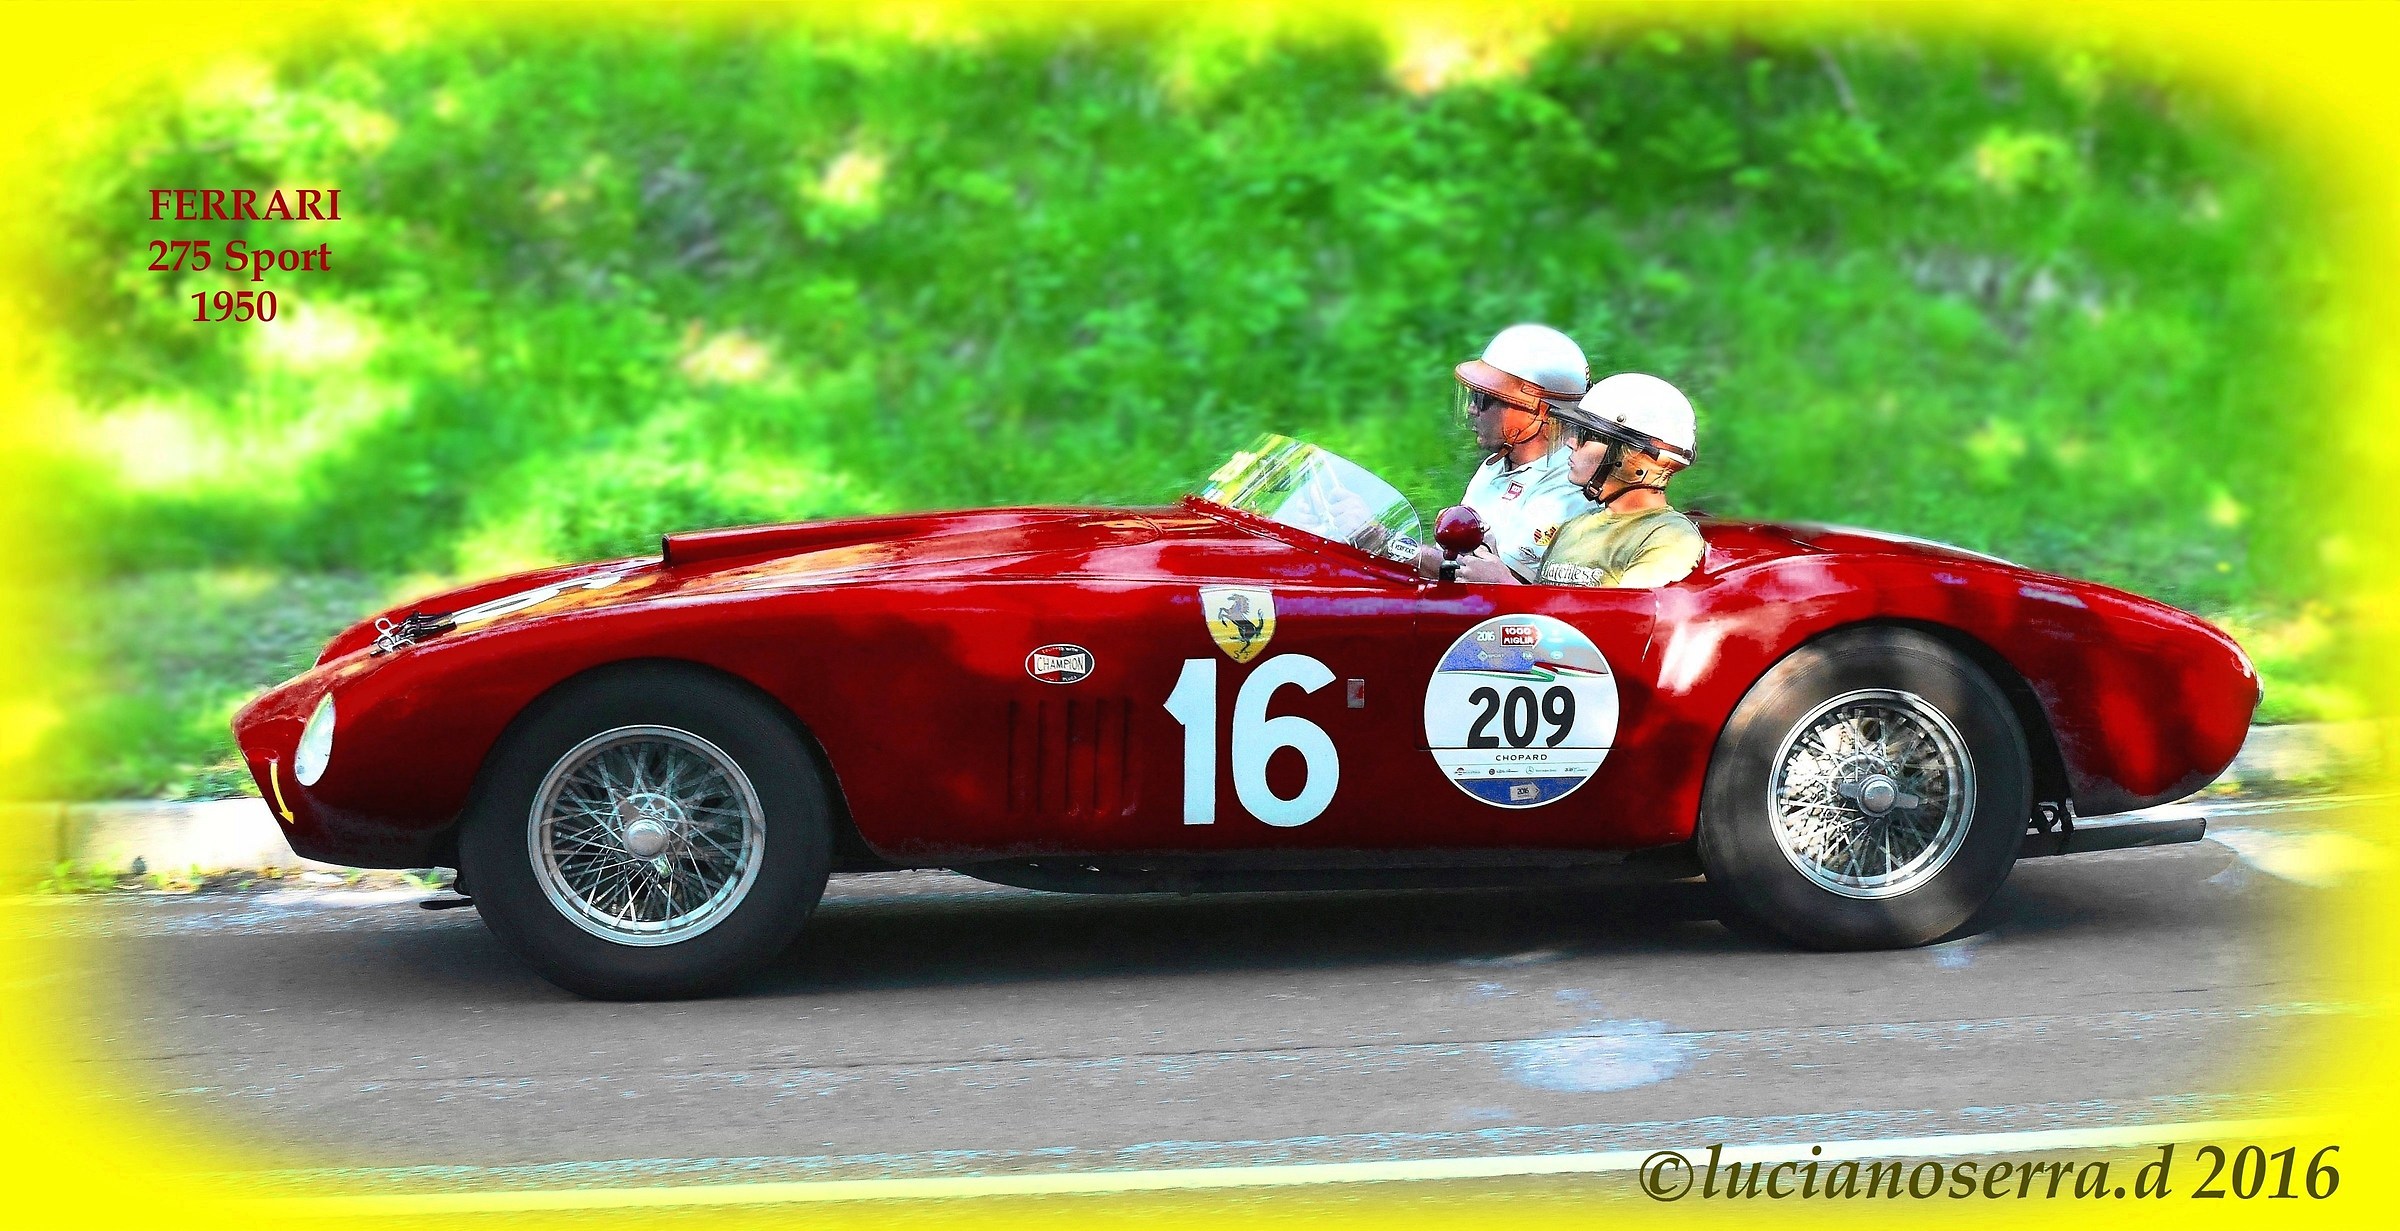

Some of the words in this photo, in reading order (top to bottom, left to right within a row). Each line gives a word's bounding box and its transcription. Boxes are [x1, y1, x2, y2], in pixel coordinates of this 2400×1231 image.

[1476, 631, 1496, 642] 2016
[1504, 627, 1532, 636] 1000
[1036, 656, 1084, 671] CHAMPION
[1467, 686, 1576, 749] 209
[1162, 653, 1340, 828] 16
[1495, 753, 1548, 762] CHOPARD
